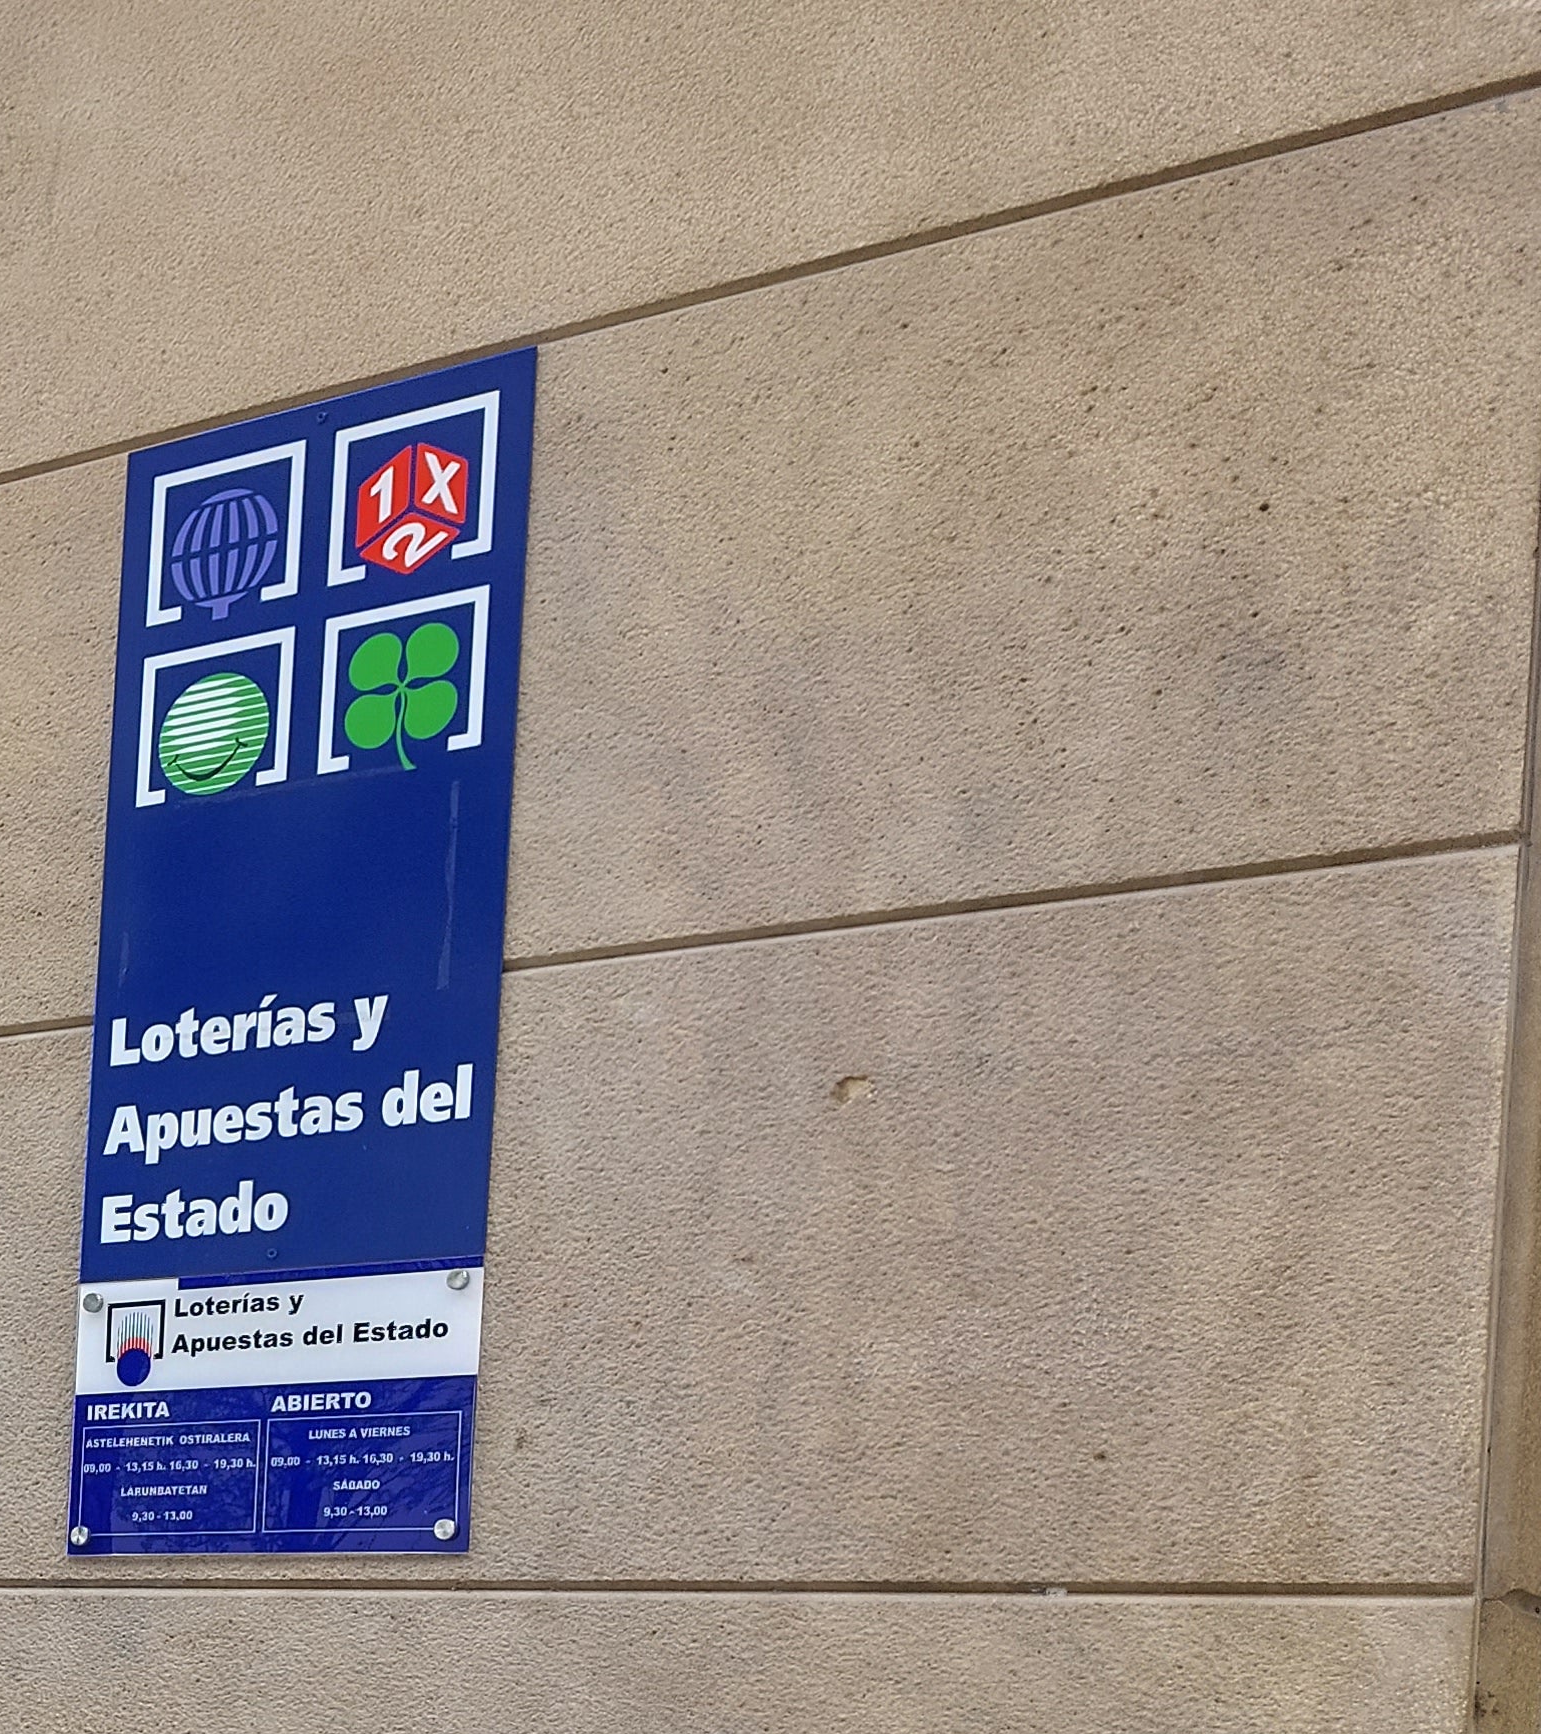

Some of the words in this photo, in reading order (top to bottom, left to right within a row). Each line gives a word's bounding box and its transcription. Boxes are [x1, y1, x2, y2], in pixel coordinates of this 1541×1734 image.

[110, 995, 335, 1067] Loterías
[352, 995, 389, 1052] y
[103, 1085, 364, 1165] Apuestas
[381, 1064, 473, 1127] del
[100, 1180, 288, 1243] Estado
[175, 1292, 280, 1317] Loterías
[288, 1292, 304, 1315] y
[171, 1328, 294, 1356] Apuestas
[303, 1324, 342, 1344] del
[353, 1319, 448, 1342] Estado
[87, 1402, 170, 1420] IREKITA
[271, 1392, 371, 1413] ABIERTO
[86, 1434, 174, 1448] ASTELEHENETIK
[179, 1433, 250, 1446] OSTIRALERA
[308, 1428, 346, 1440] LUNES
[349, 1428, 358, 1438] A
[360, 1425, 411, 1438] VIERNES
